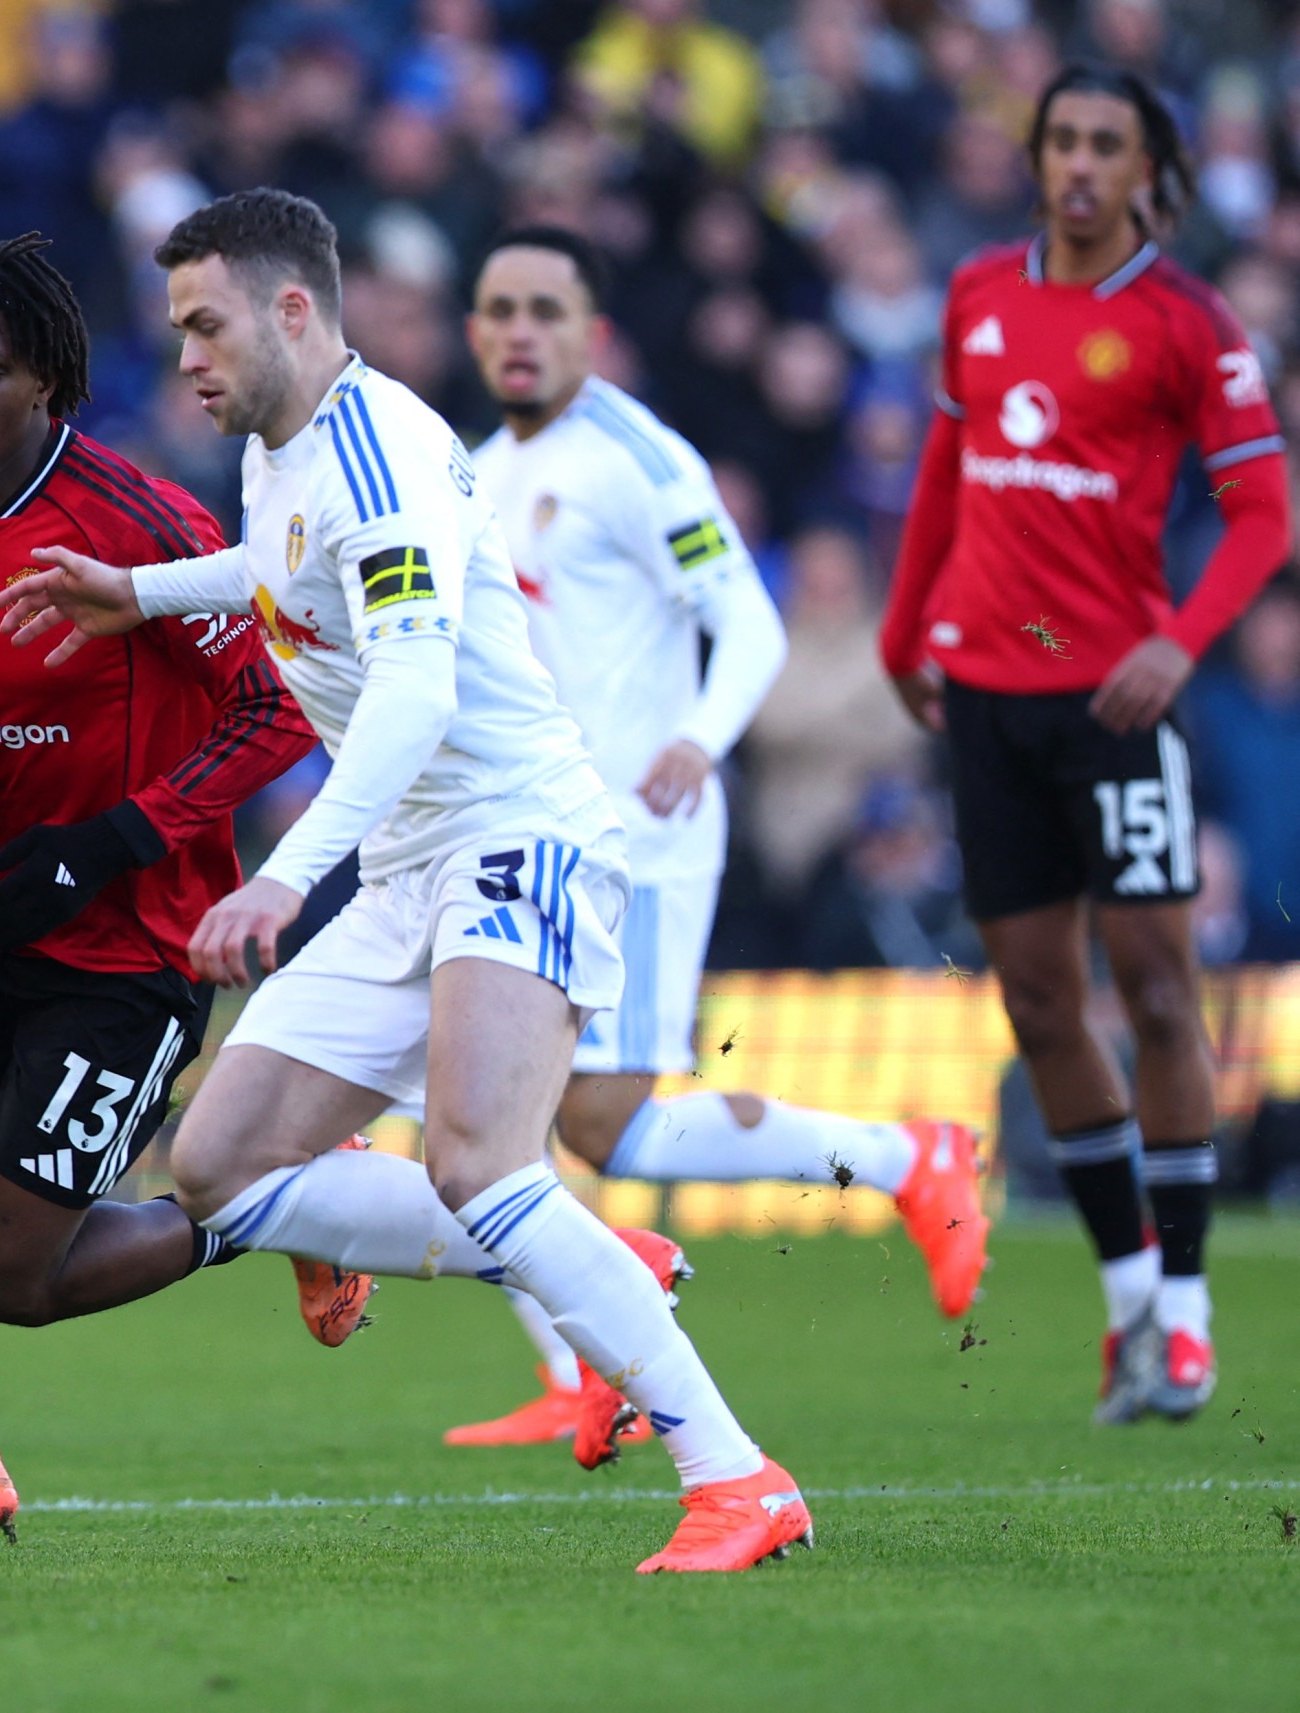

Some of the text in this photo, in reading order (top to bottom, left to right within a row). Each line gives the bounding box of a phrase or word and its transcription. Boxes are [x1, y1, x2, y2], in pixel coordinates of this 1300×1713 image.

[202, 614, 257, 658] TECHNOL
[1092, 777, 1167, 860] 15
[476, 849, 525, 901] 3
[37, 1051, 135, 1153] 13
